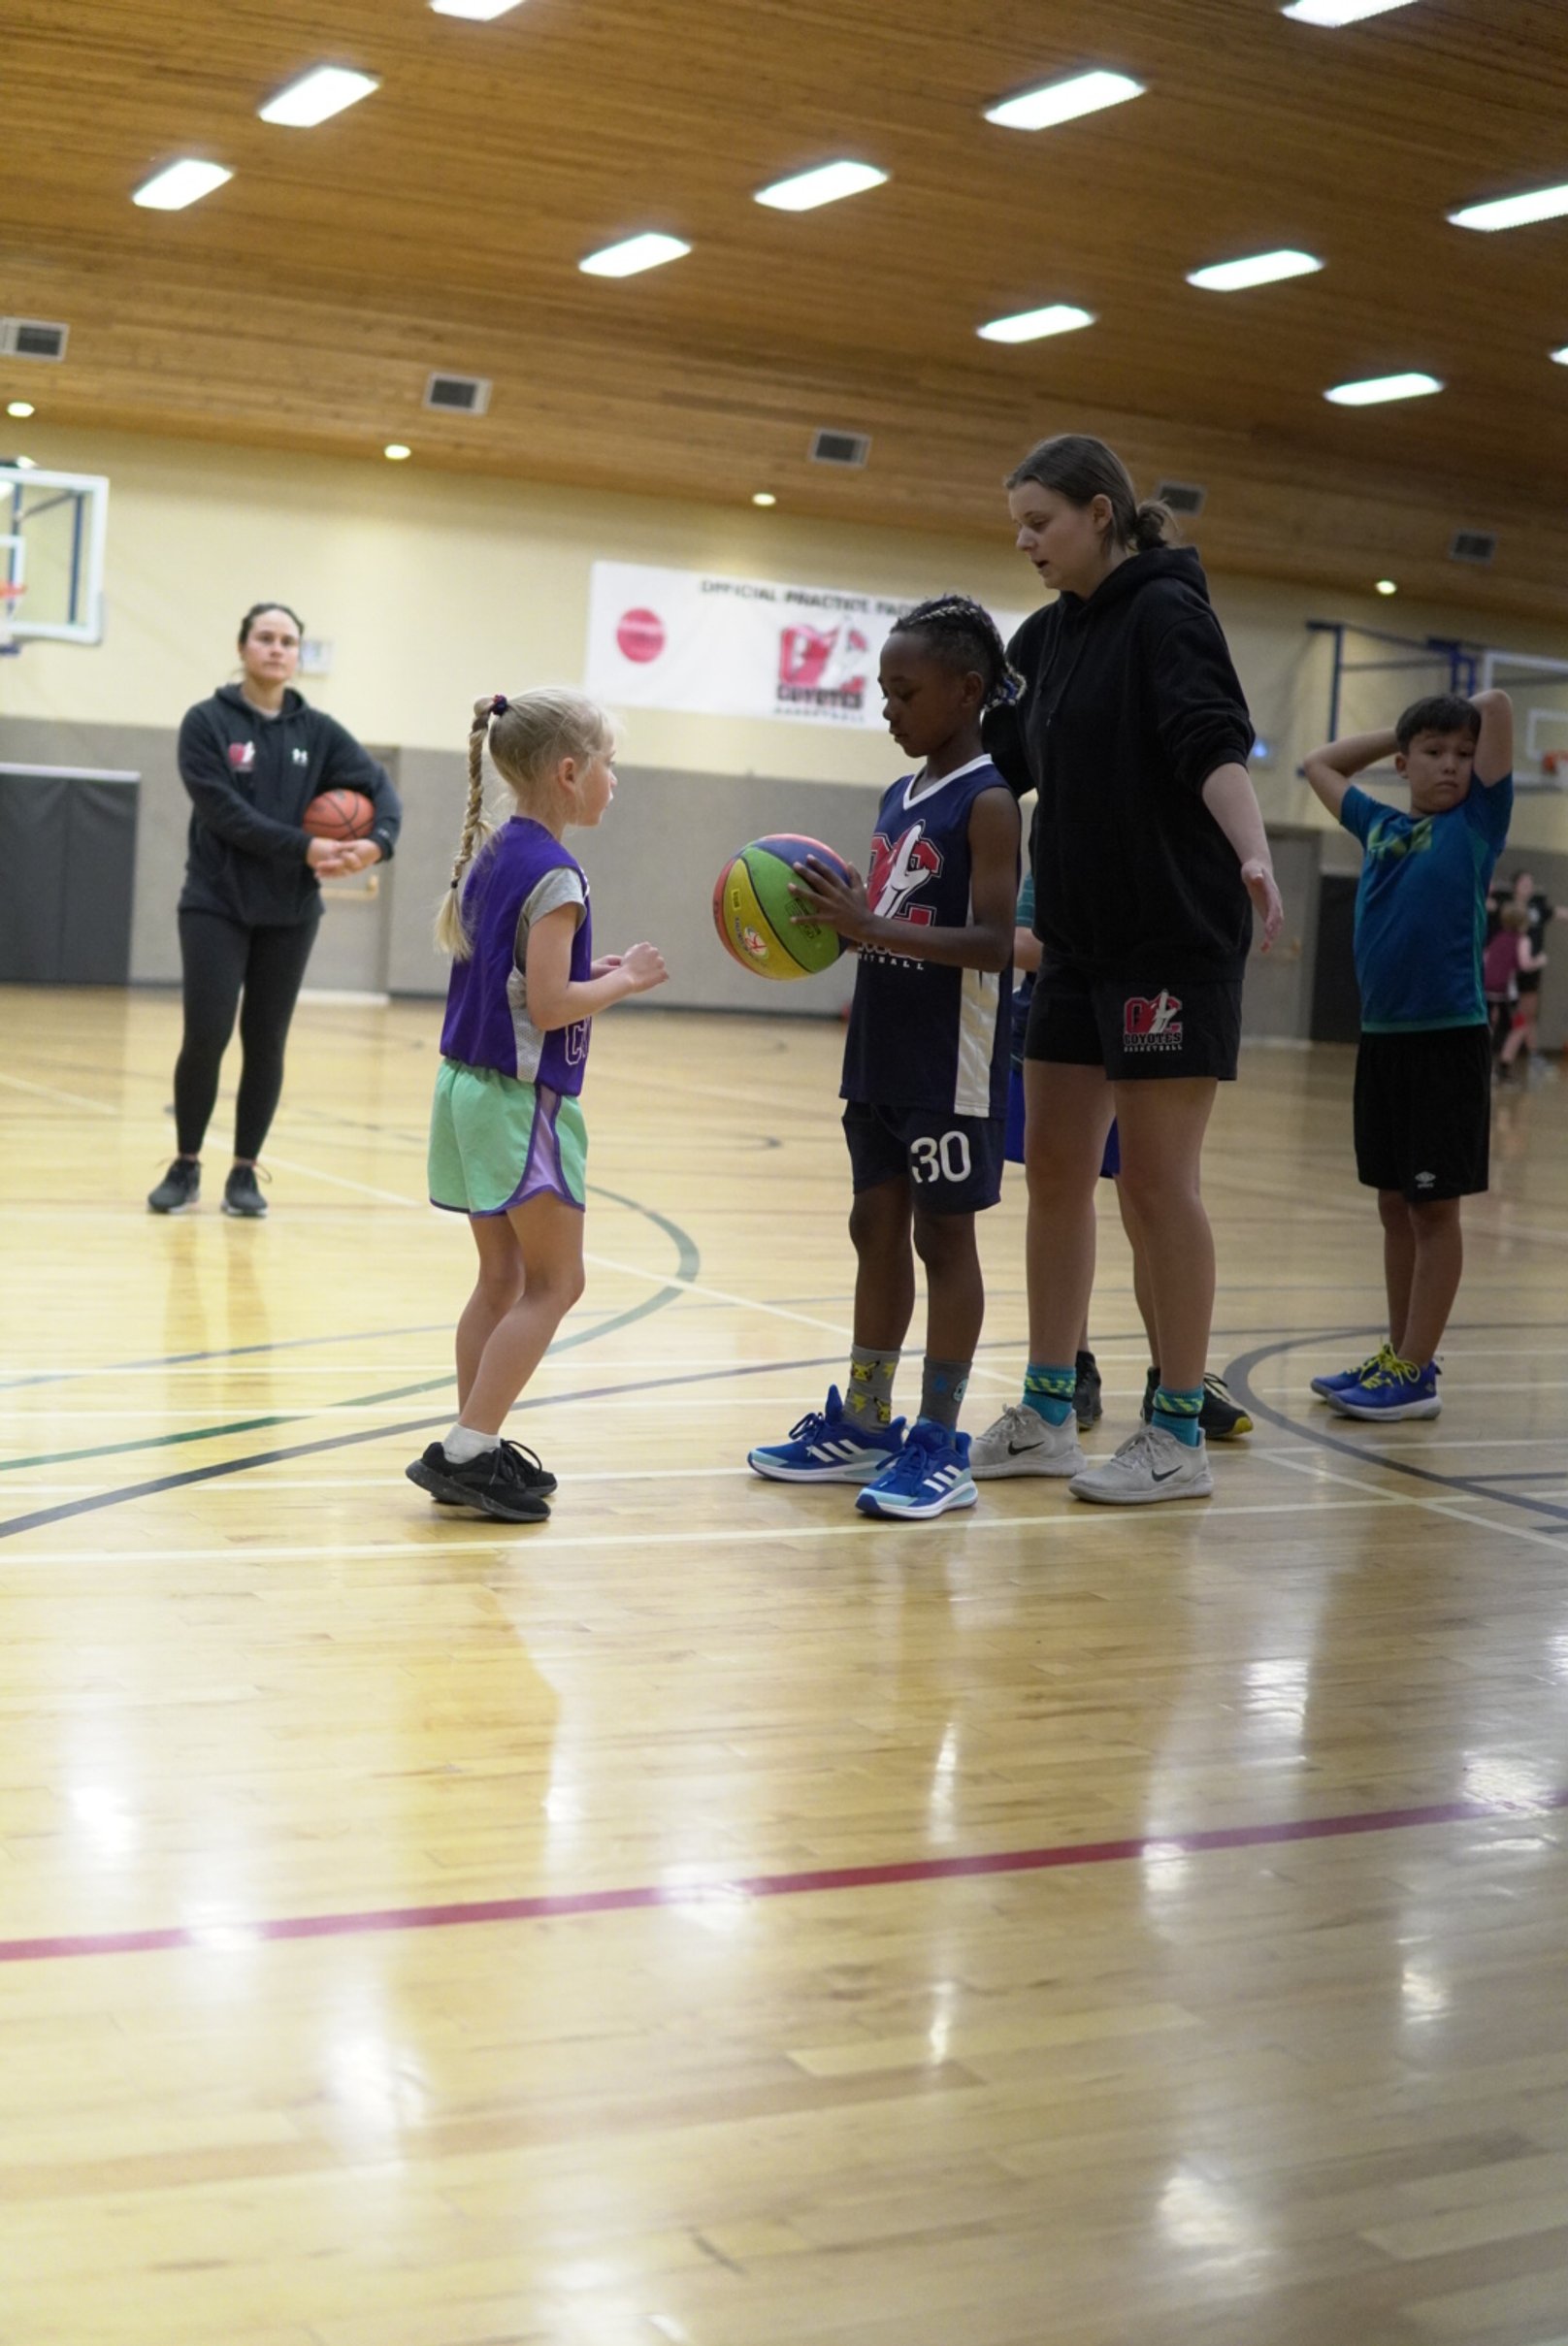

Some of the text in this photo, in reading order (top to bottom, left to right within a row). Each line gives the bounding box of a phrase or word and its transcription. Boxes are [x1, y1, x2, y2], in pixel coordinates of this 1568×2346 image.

[701, 580, 776, 602] OFFICIAL
[786, 590, 869, 613] PRACTICE
[1124, 1032, 1183, 1045] COYOTES
[910, 1130, 971, 1184] 30
